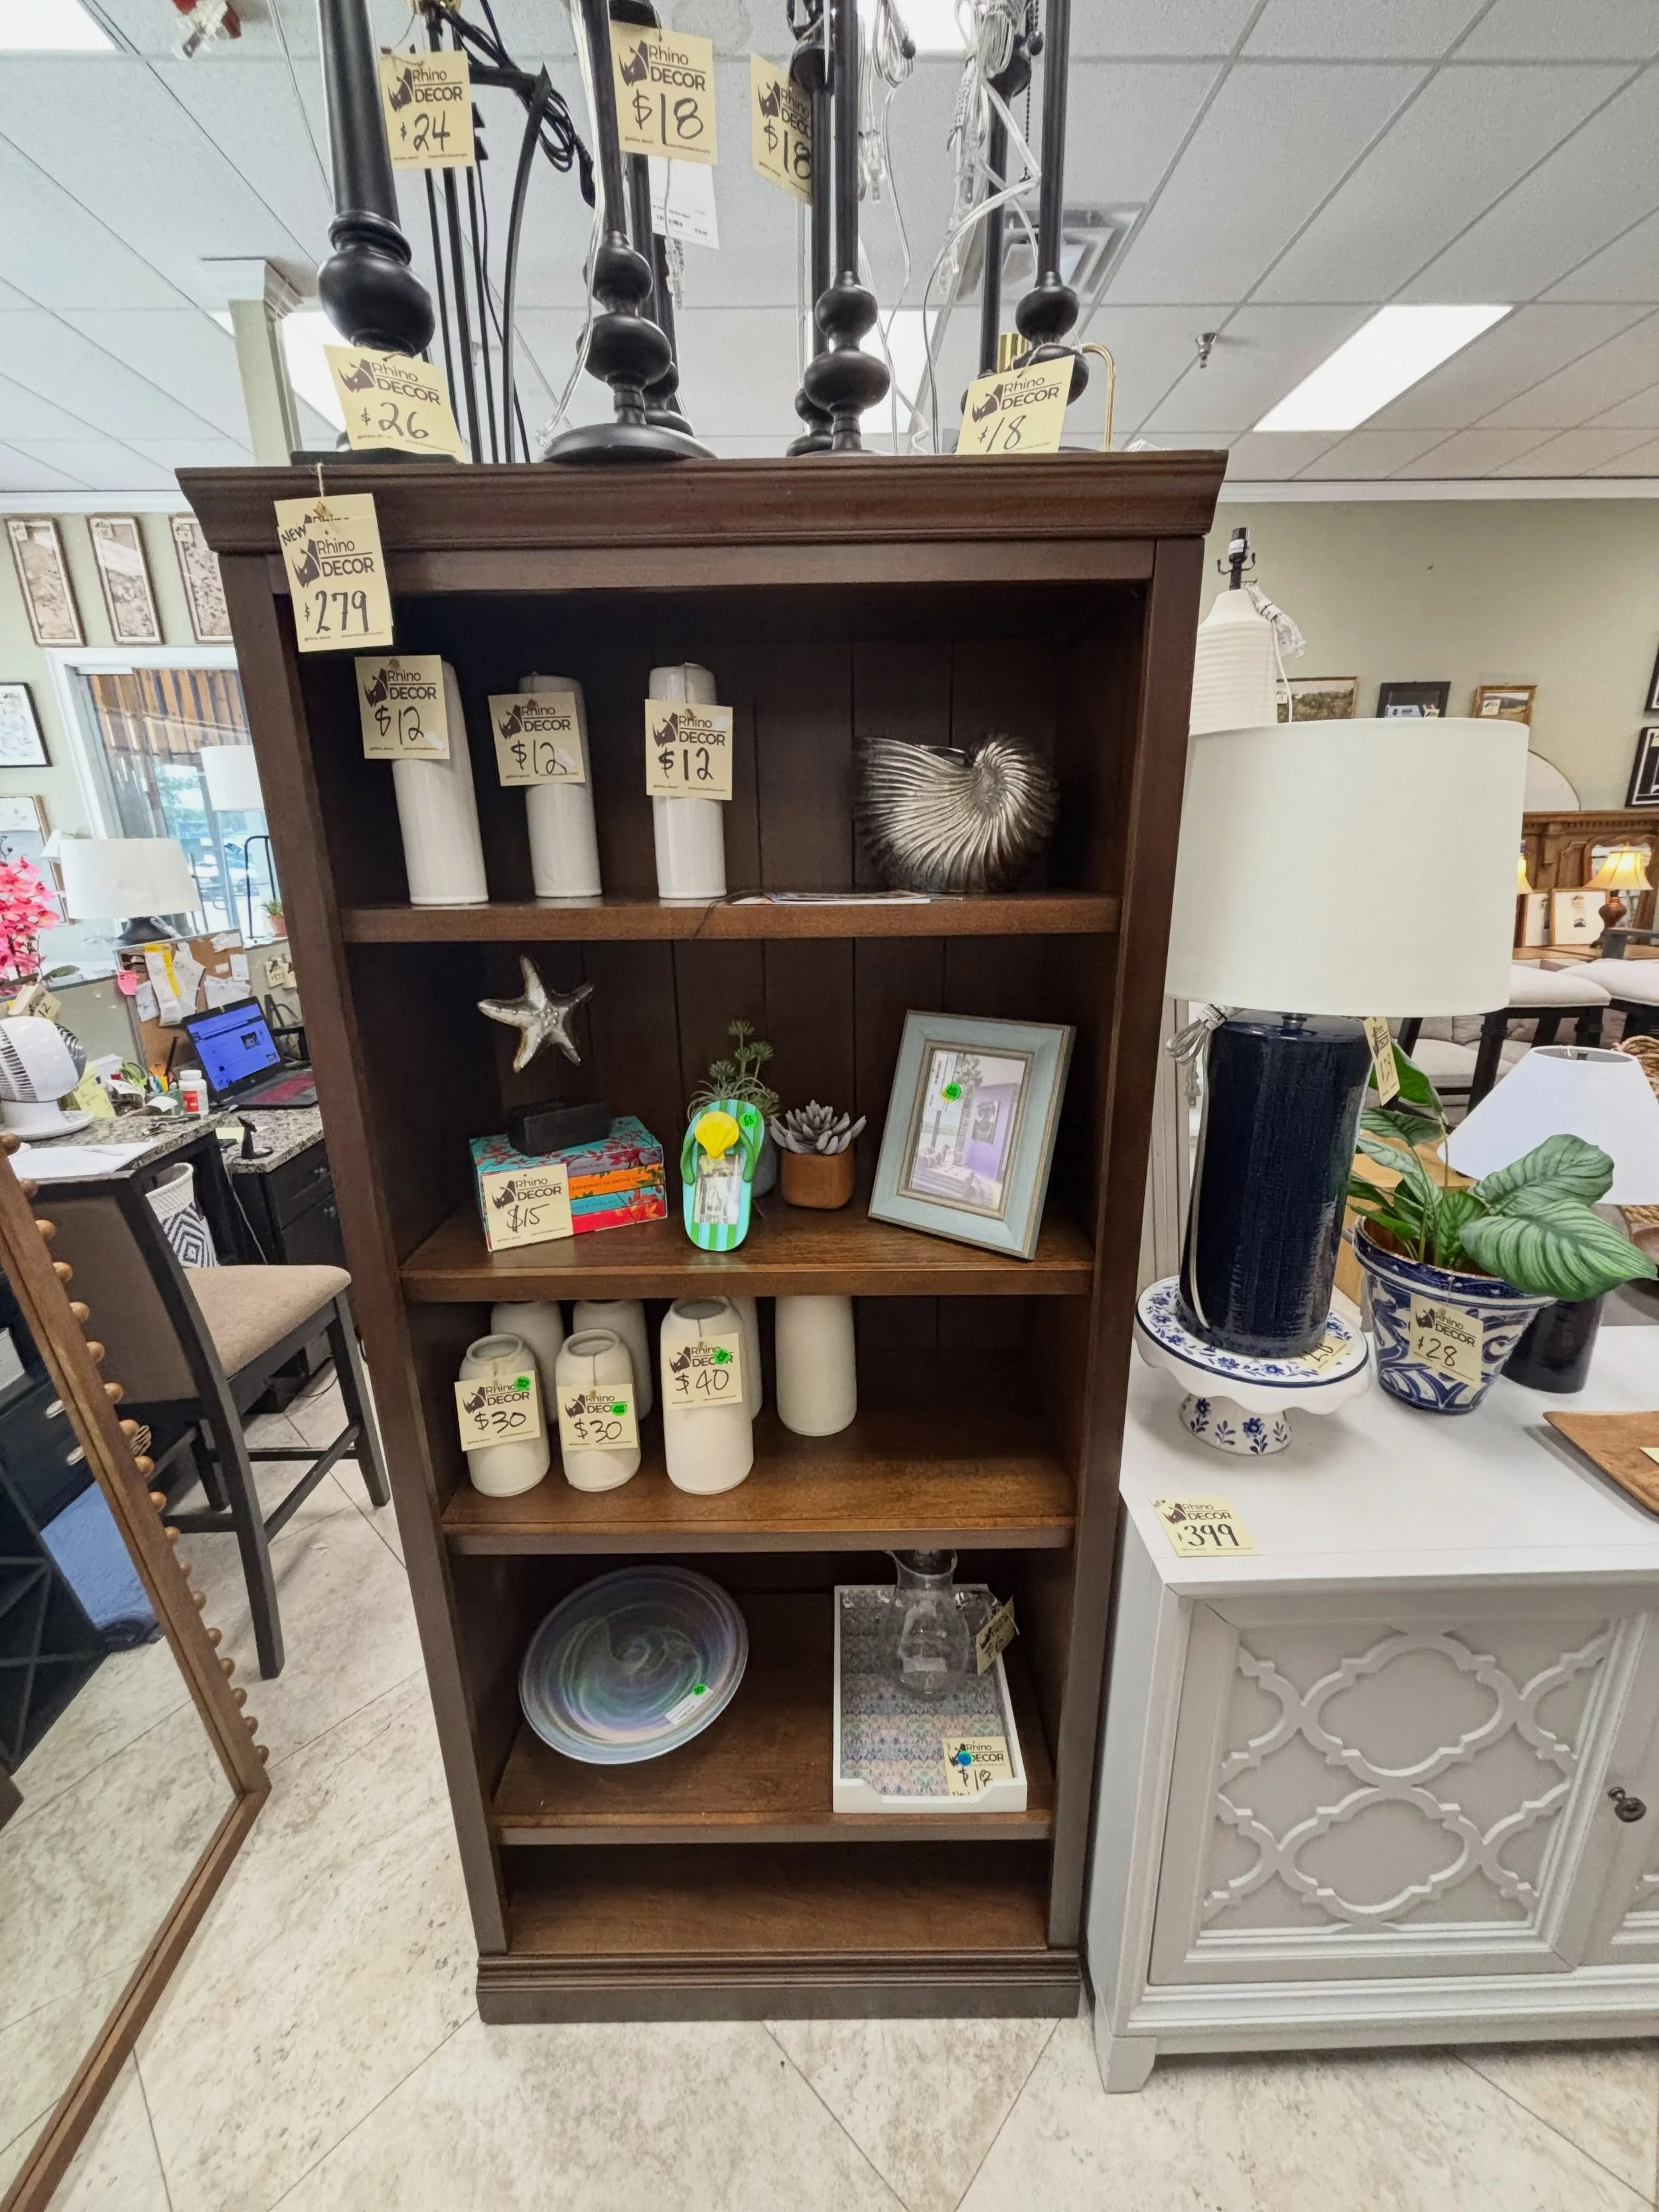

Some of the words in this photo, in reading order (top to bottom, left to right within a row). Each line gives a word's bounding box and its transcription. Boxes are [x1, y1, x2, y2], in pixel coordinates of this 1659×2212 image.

[649, 44, 689, 65] Rhino
[412, 68, 447, 82] Rhino
[650, 66, 706, 92] DECOR
[415, 86, 463, 103] DECOR
[781, 88, 810, 118] Rhino
[632, 89, 703, 146] $18
[782, 107, 812, 139] DECO
[400, 110, 451, 151] $24
[764, 119, 812, 180] $18
[372, 362, 418, 382] Rhino
[376, 378, 441, 406] DECOR
[1003, 377, 1045, 394] Rhino
[1001, 386, 1060, 411] DECOR
[360, 402, 429, 439] $26
[977, 414, 1027, 453] $18
[281, 524, 306, 546] NEW
[317, 538, 355, 555] Rhino
[321, 557, 376, 577] DECOR
[305, 590, 369, 634] $279
[388, 669, 421, 682] Rhino
[390, 686, 437, 700] DECOR
[521, 705, 555, 715] Rhino
[374, 705, 424, 745] $12
[524, 719, 571, 732] DECOR
[679, 715, 713, 728] Rhino
[679, 731, 725, 746] DECOR
[510, 740, 567, 774] $12
[658, 747, 714, 781] $12
[516, 1177, 548, 1189] Rhino
[517, 1186, 562, 1201] DECOR
[506, 1203, 550, 1234] $15
[1435, 1312, 1464, 1330] Rhino
[1435, 1323, 1476, 1347] DECOR
[691, 1345, 721, 1355] Rhino
[1417, 1336, 1457, 1366] $28
[692, 1355, 733, 1367] DECR
[675, 1369, 729, 1396] $40
[487, 1392, 530, 1406] DECOR
[587, 1404, 628, 1414] DEC
[474, 1411, 526, 1434] $30
[574, 1418, 622, 1443] $30
[1187, 1512, 1232, 1520] DECOR
[1177, 1524, 1240, 1546] $399
[966, 1743, 992, 1751] Rhino
